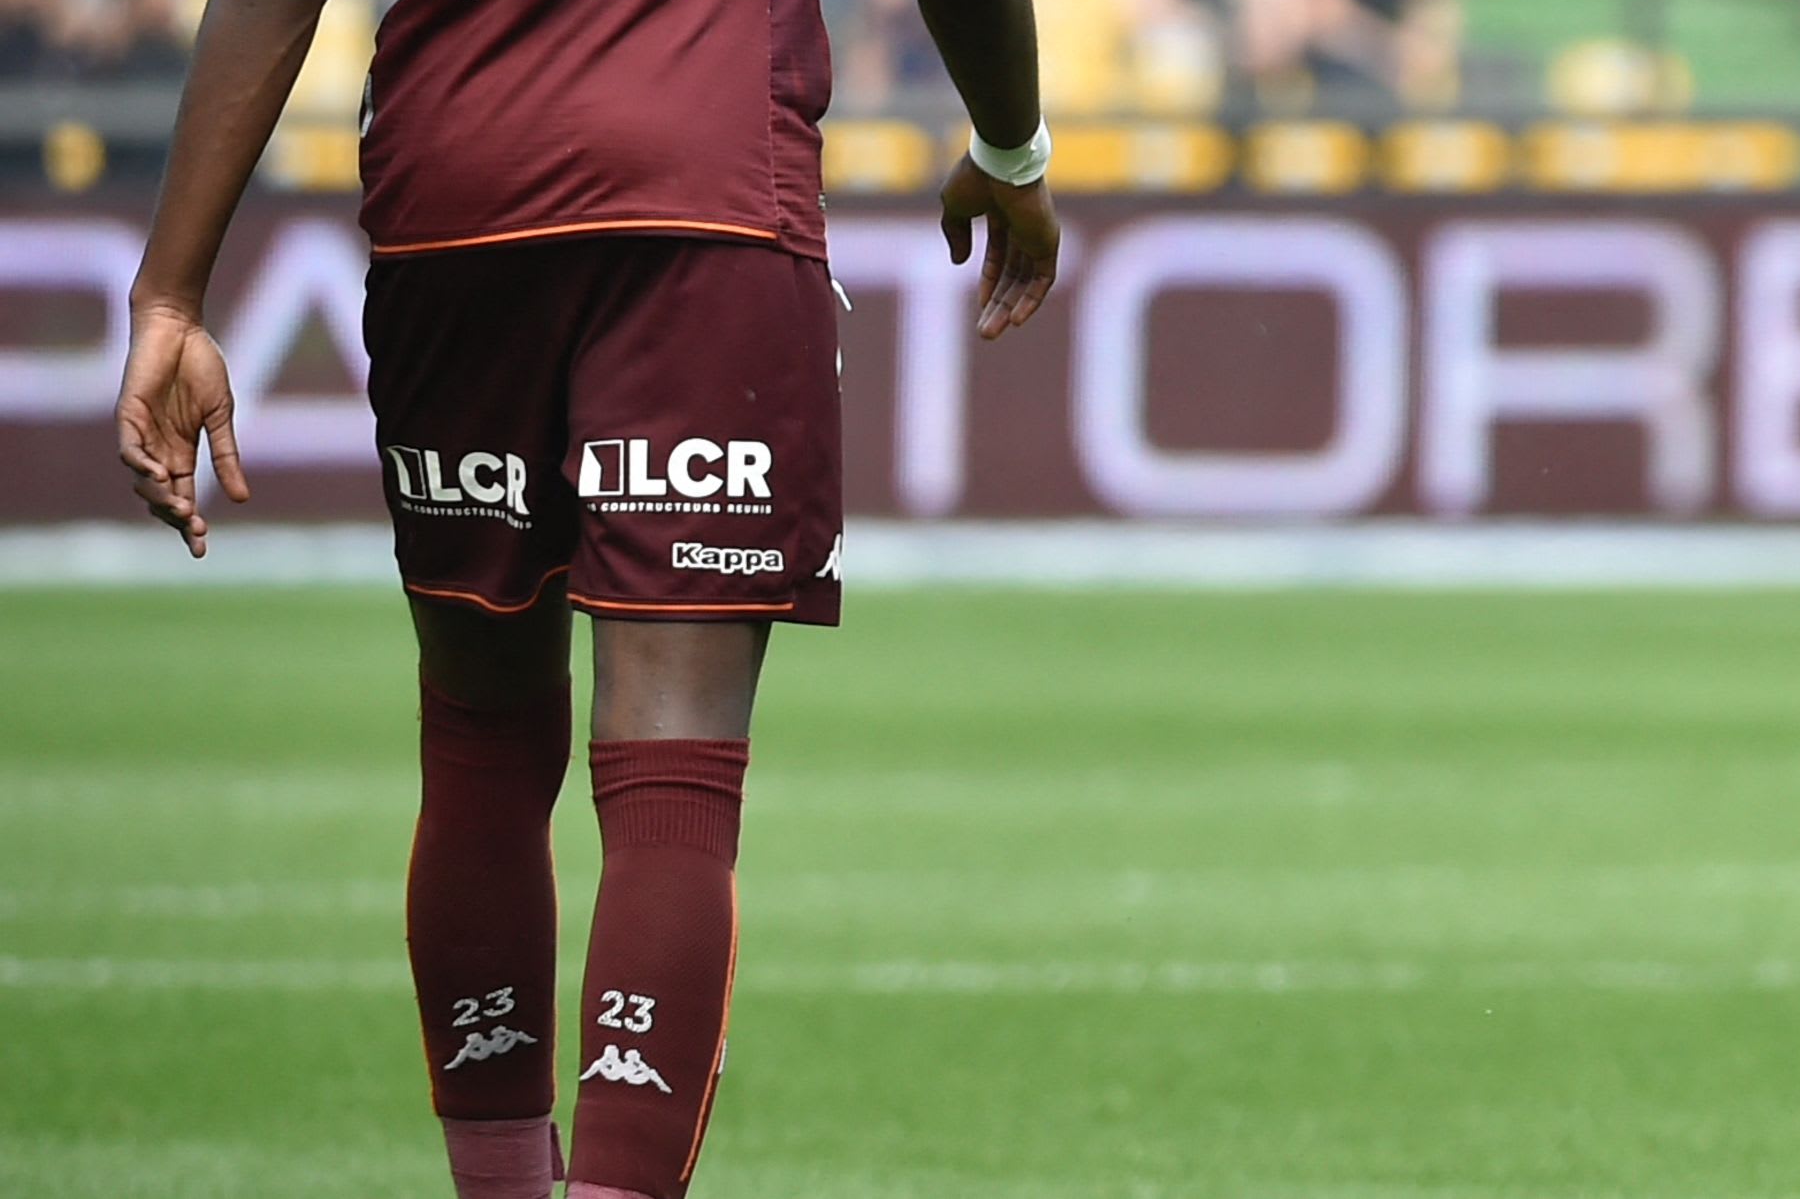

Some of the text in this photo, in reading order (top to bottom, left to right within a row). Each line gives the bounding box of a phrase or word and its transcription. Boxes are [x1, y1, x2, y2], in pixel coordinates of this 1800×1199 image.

[424, 449, 530, 515] LCR
[629, 437, 772, 498] LCR
[672, 542, 785, 574] Kappa
[452, 986, 515, 1027] 23
[597, 989, 656, 1033] 23
